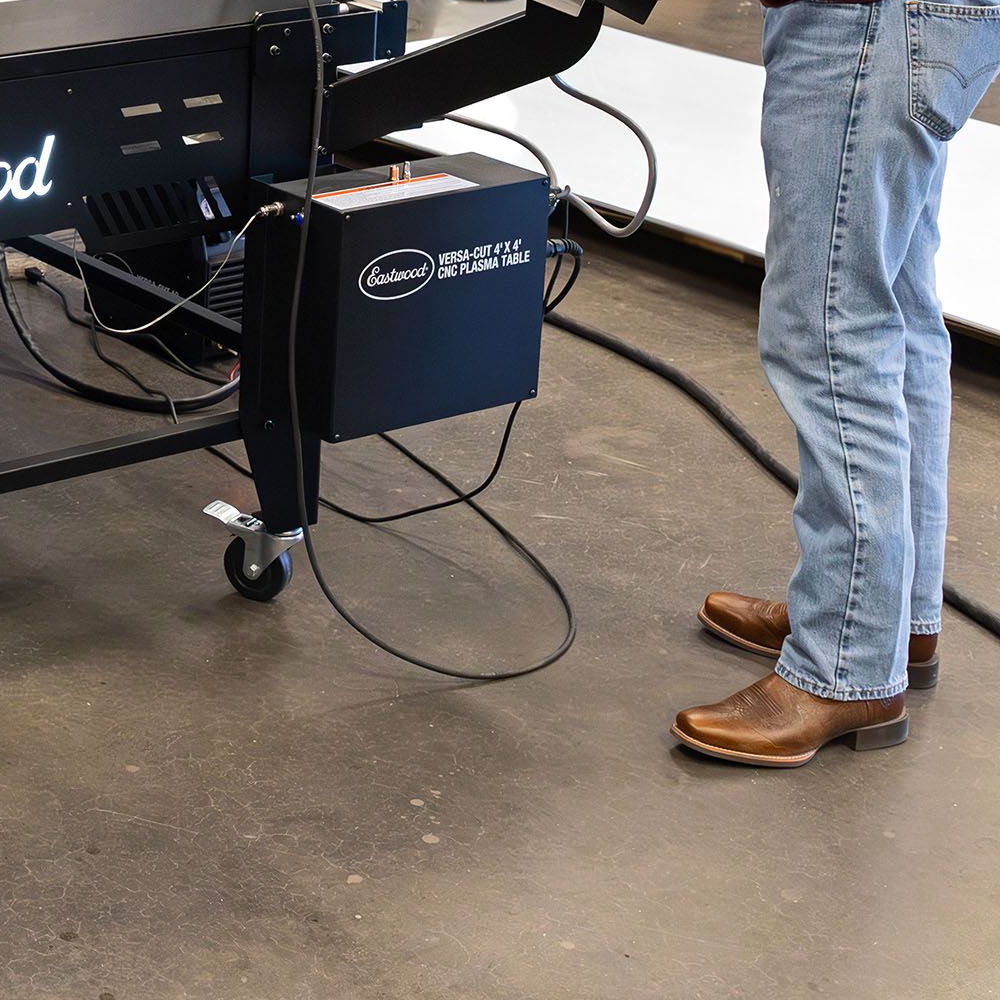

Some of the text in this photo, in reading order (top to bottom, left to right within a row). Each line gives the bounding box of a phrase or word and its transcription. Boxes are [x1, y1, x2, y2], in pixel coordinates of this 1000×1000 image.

[437, 250, 531, 280] CNC PLASMA TABLE
[438, 244, 493, 266] VERSA-CUT
[504, 240, 511, 253] X
[366, 262, 427, 287] Eastwood
